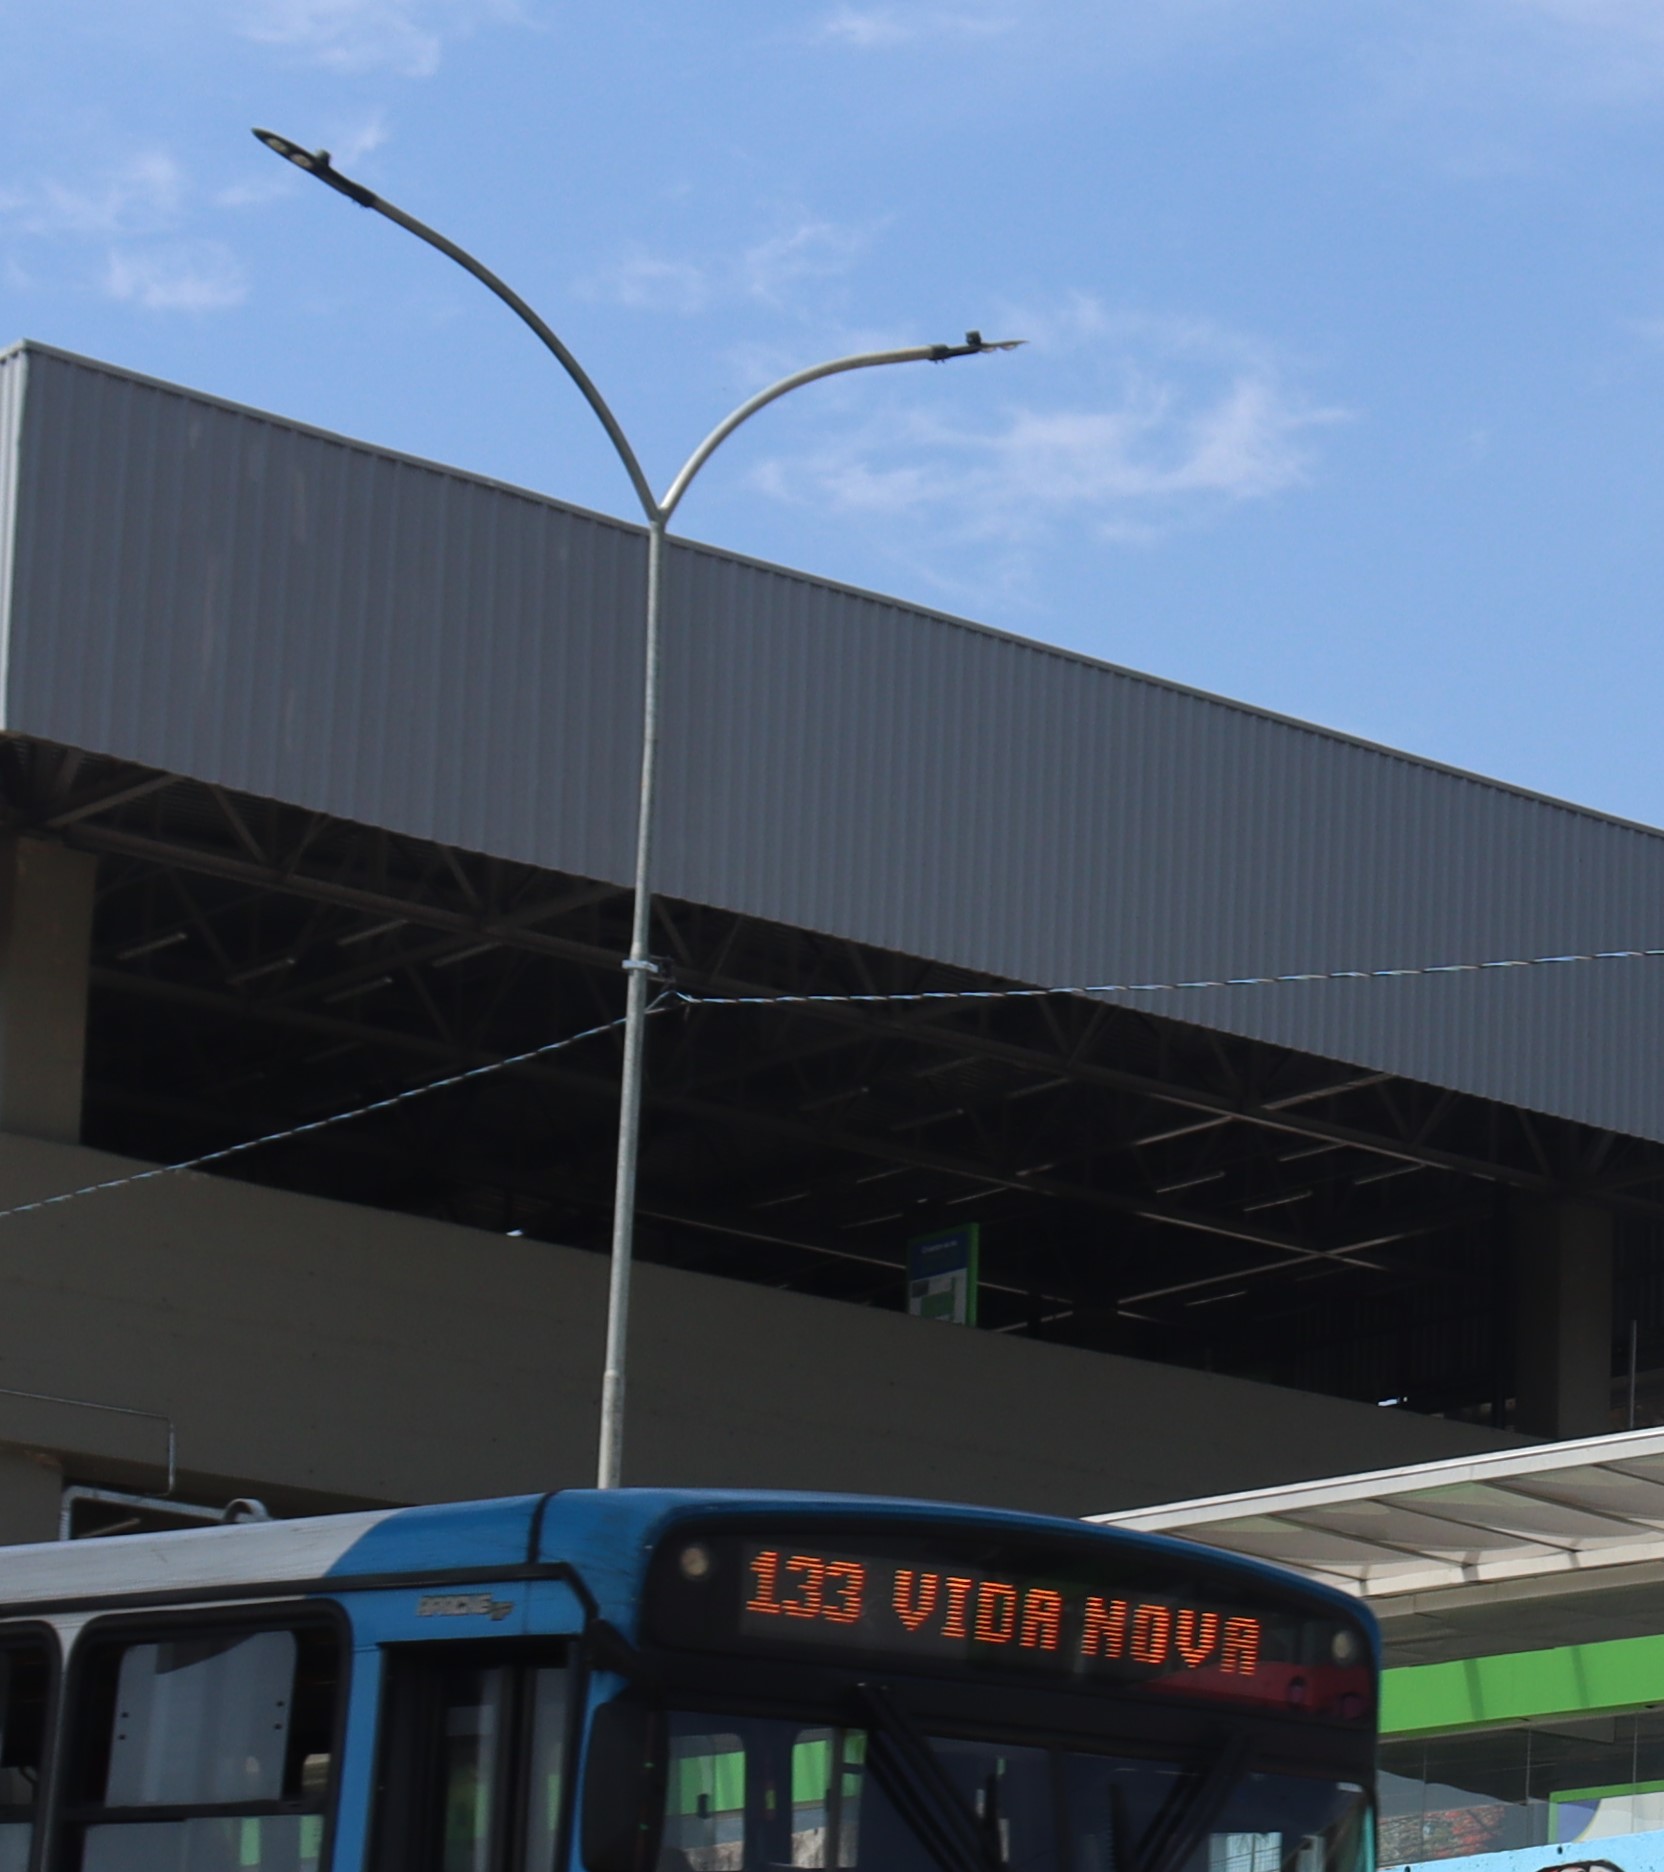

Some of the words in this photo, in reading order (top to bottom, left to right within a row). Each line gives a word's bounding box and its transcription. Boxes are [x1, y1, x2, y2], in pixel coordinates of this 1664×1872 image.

[745, 1550, 866, 1624] 133
[891, 1567, 1062, 1651] VIDA
[1080, 1595, 1262, 1677] NOVA
